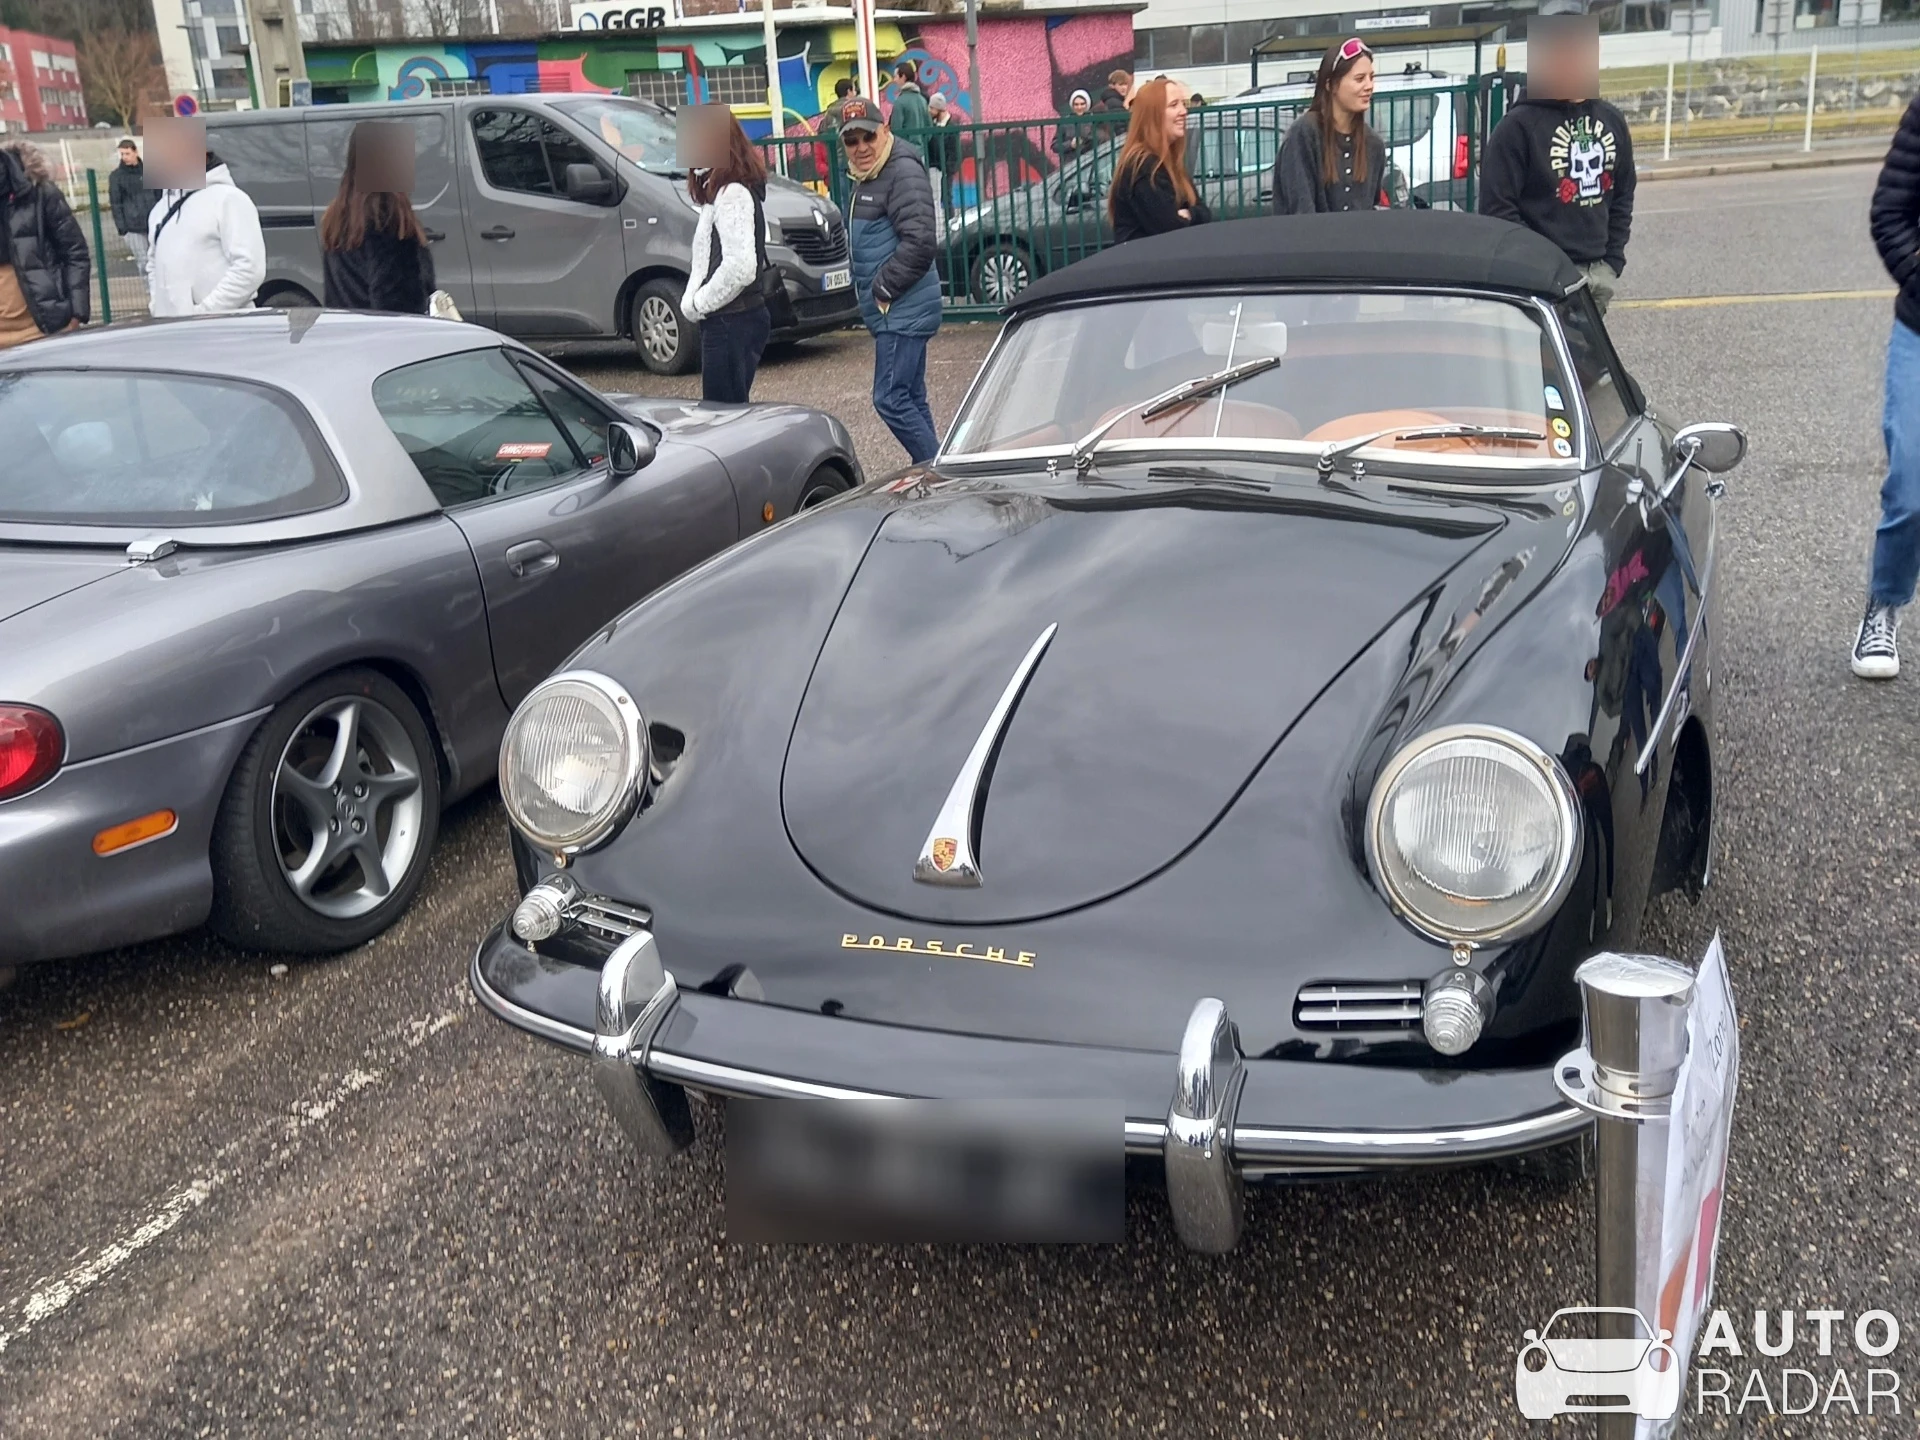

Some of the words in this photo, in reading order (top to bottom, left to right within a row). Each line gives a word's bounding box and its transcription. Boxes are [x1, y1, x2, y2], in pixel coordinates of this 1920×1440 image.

[602, 7, 665, 30] GGB
[1601, 131, 1616, 163] DIE
[841, 933, 1036, 968] PORSCHE
